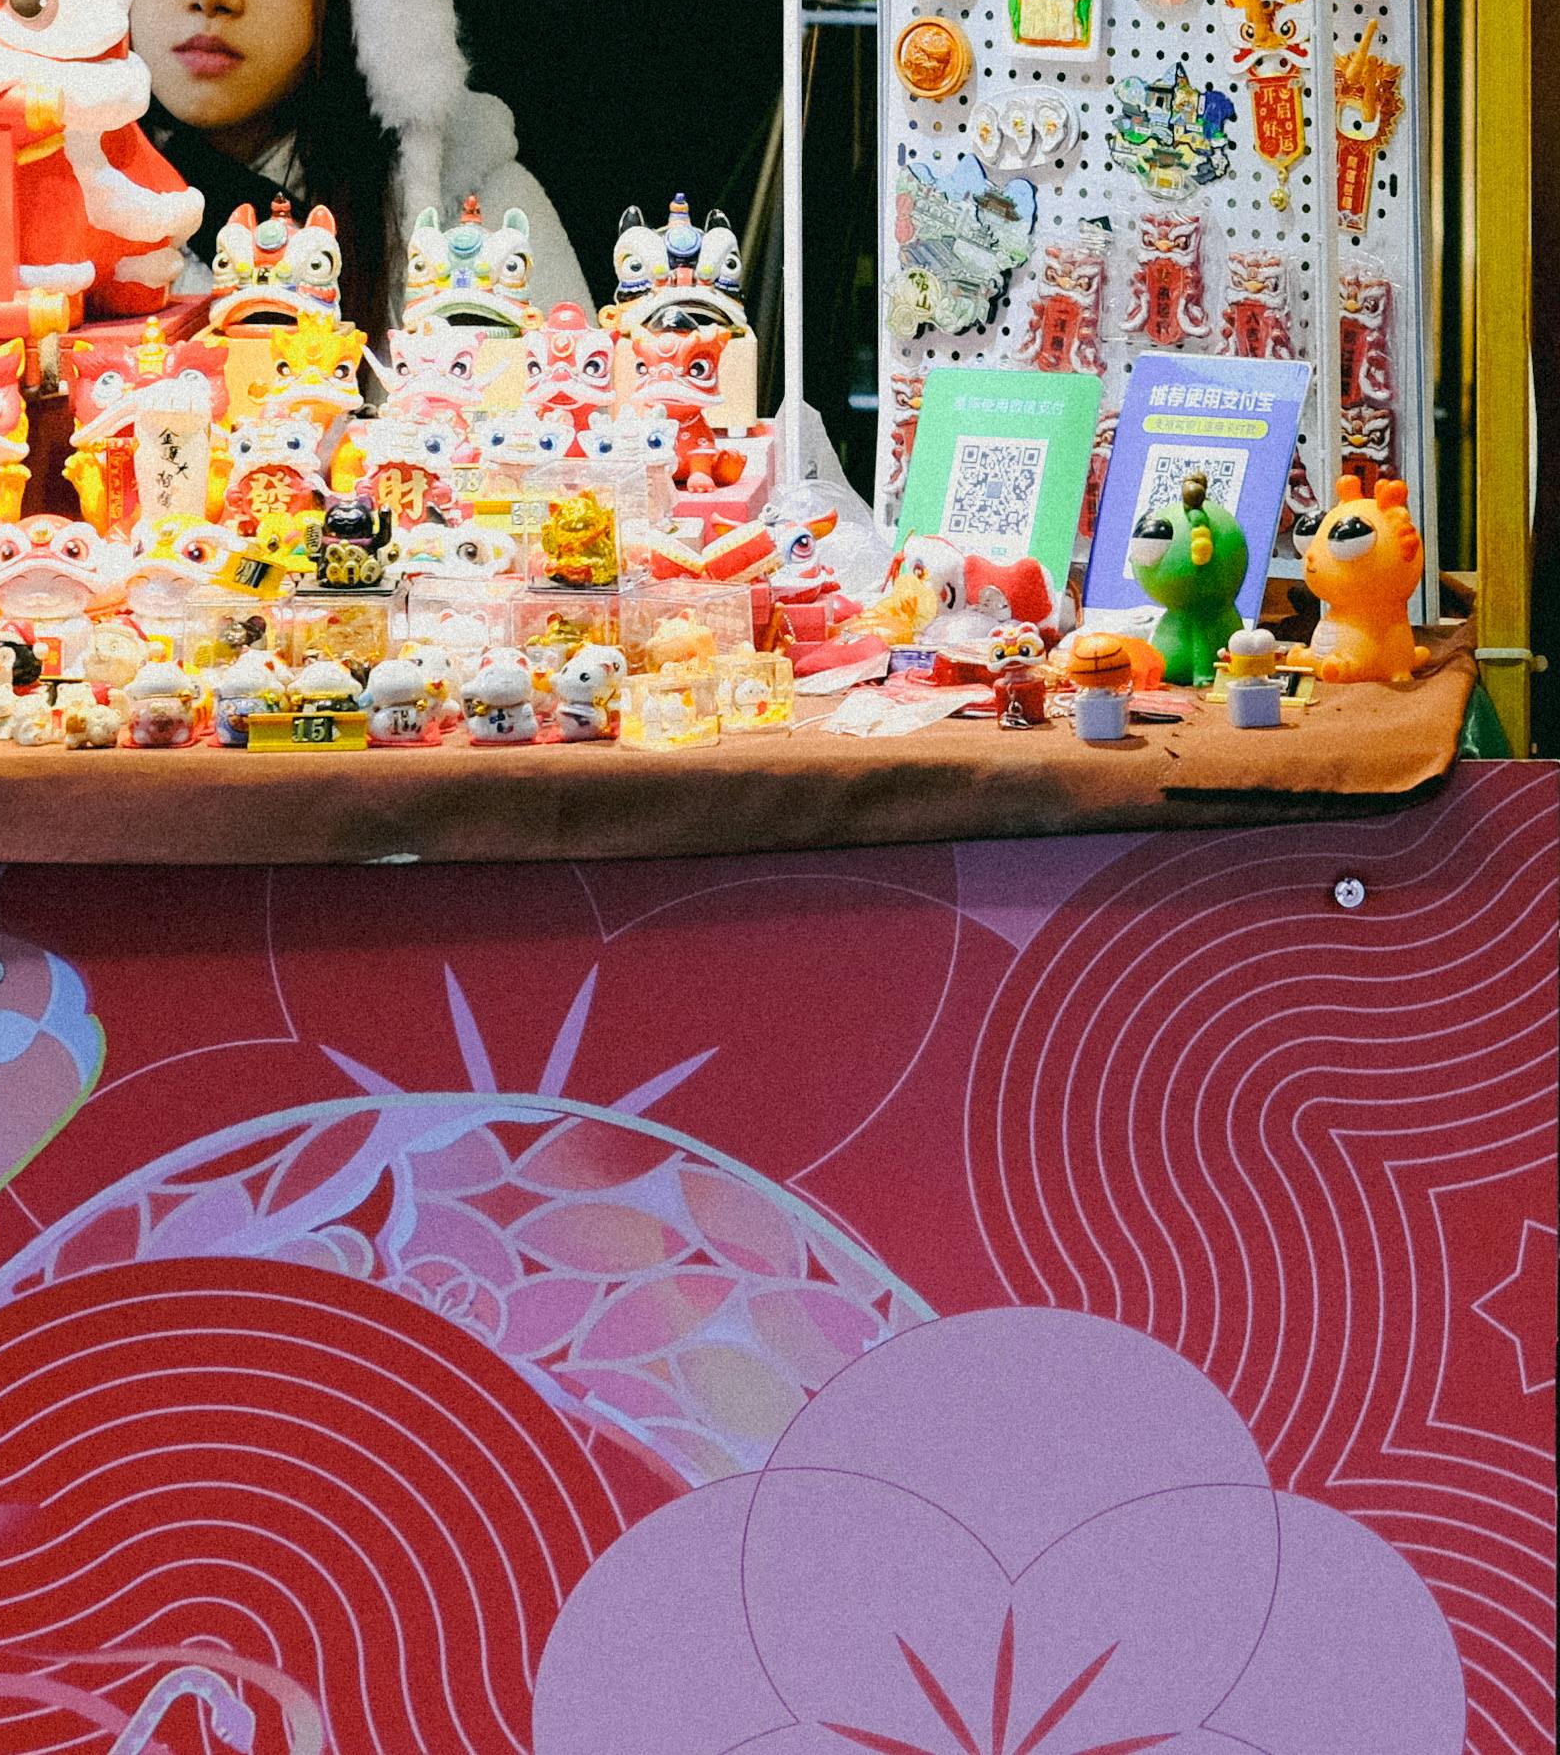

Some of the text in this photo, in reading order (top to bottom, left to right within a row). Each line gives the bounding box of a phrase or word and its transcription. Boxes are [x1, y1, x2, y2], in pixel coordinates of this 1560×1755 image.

[908, 272, 932, 312] 佛山
[1149, 385, 1276, 413] 推荐使用支付宝
[249, 471, 293, 522] 發
[377, 468, 430, 526] 財
[292, 717, 327, 743] 15
